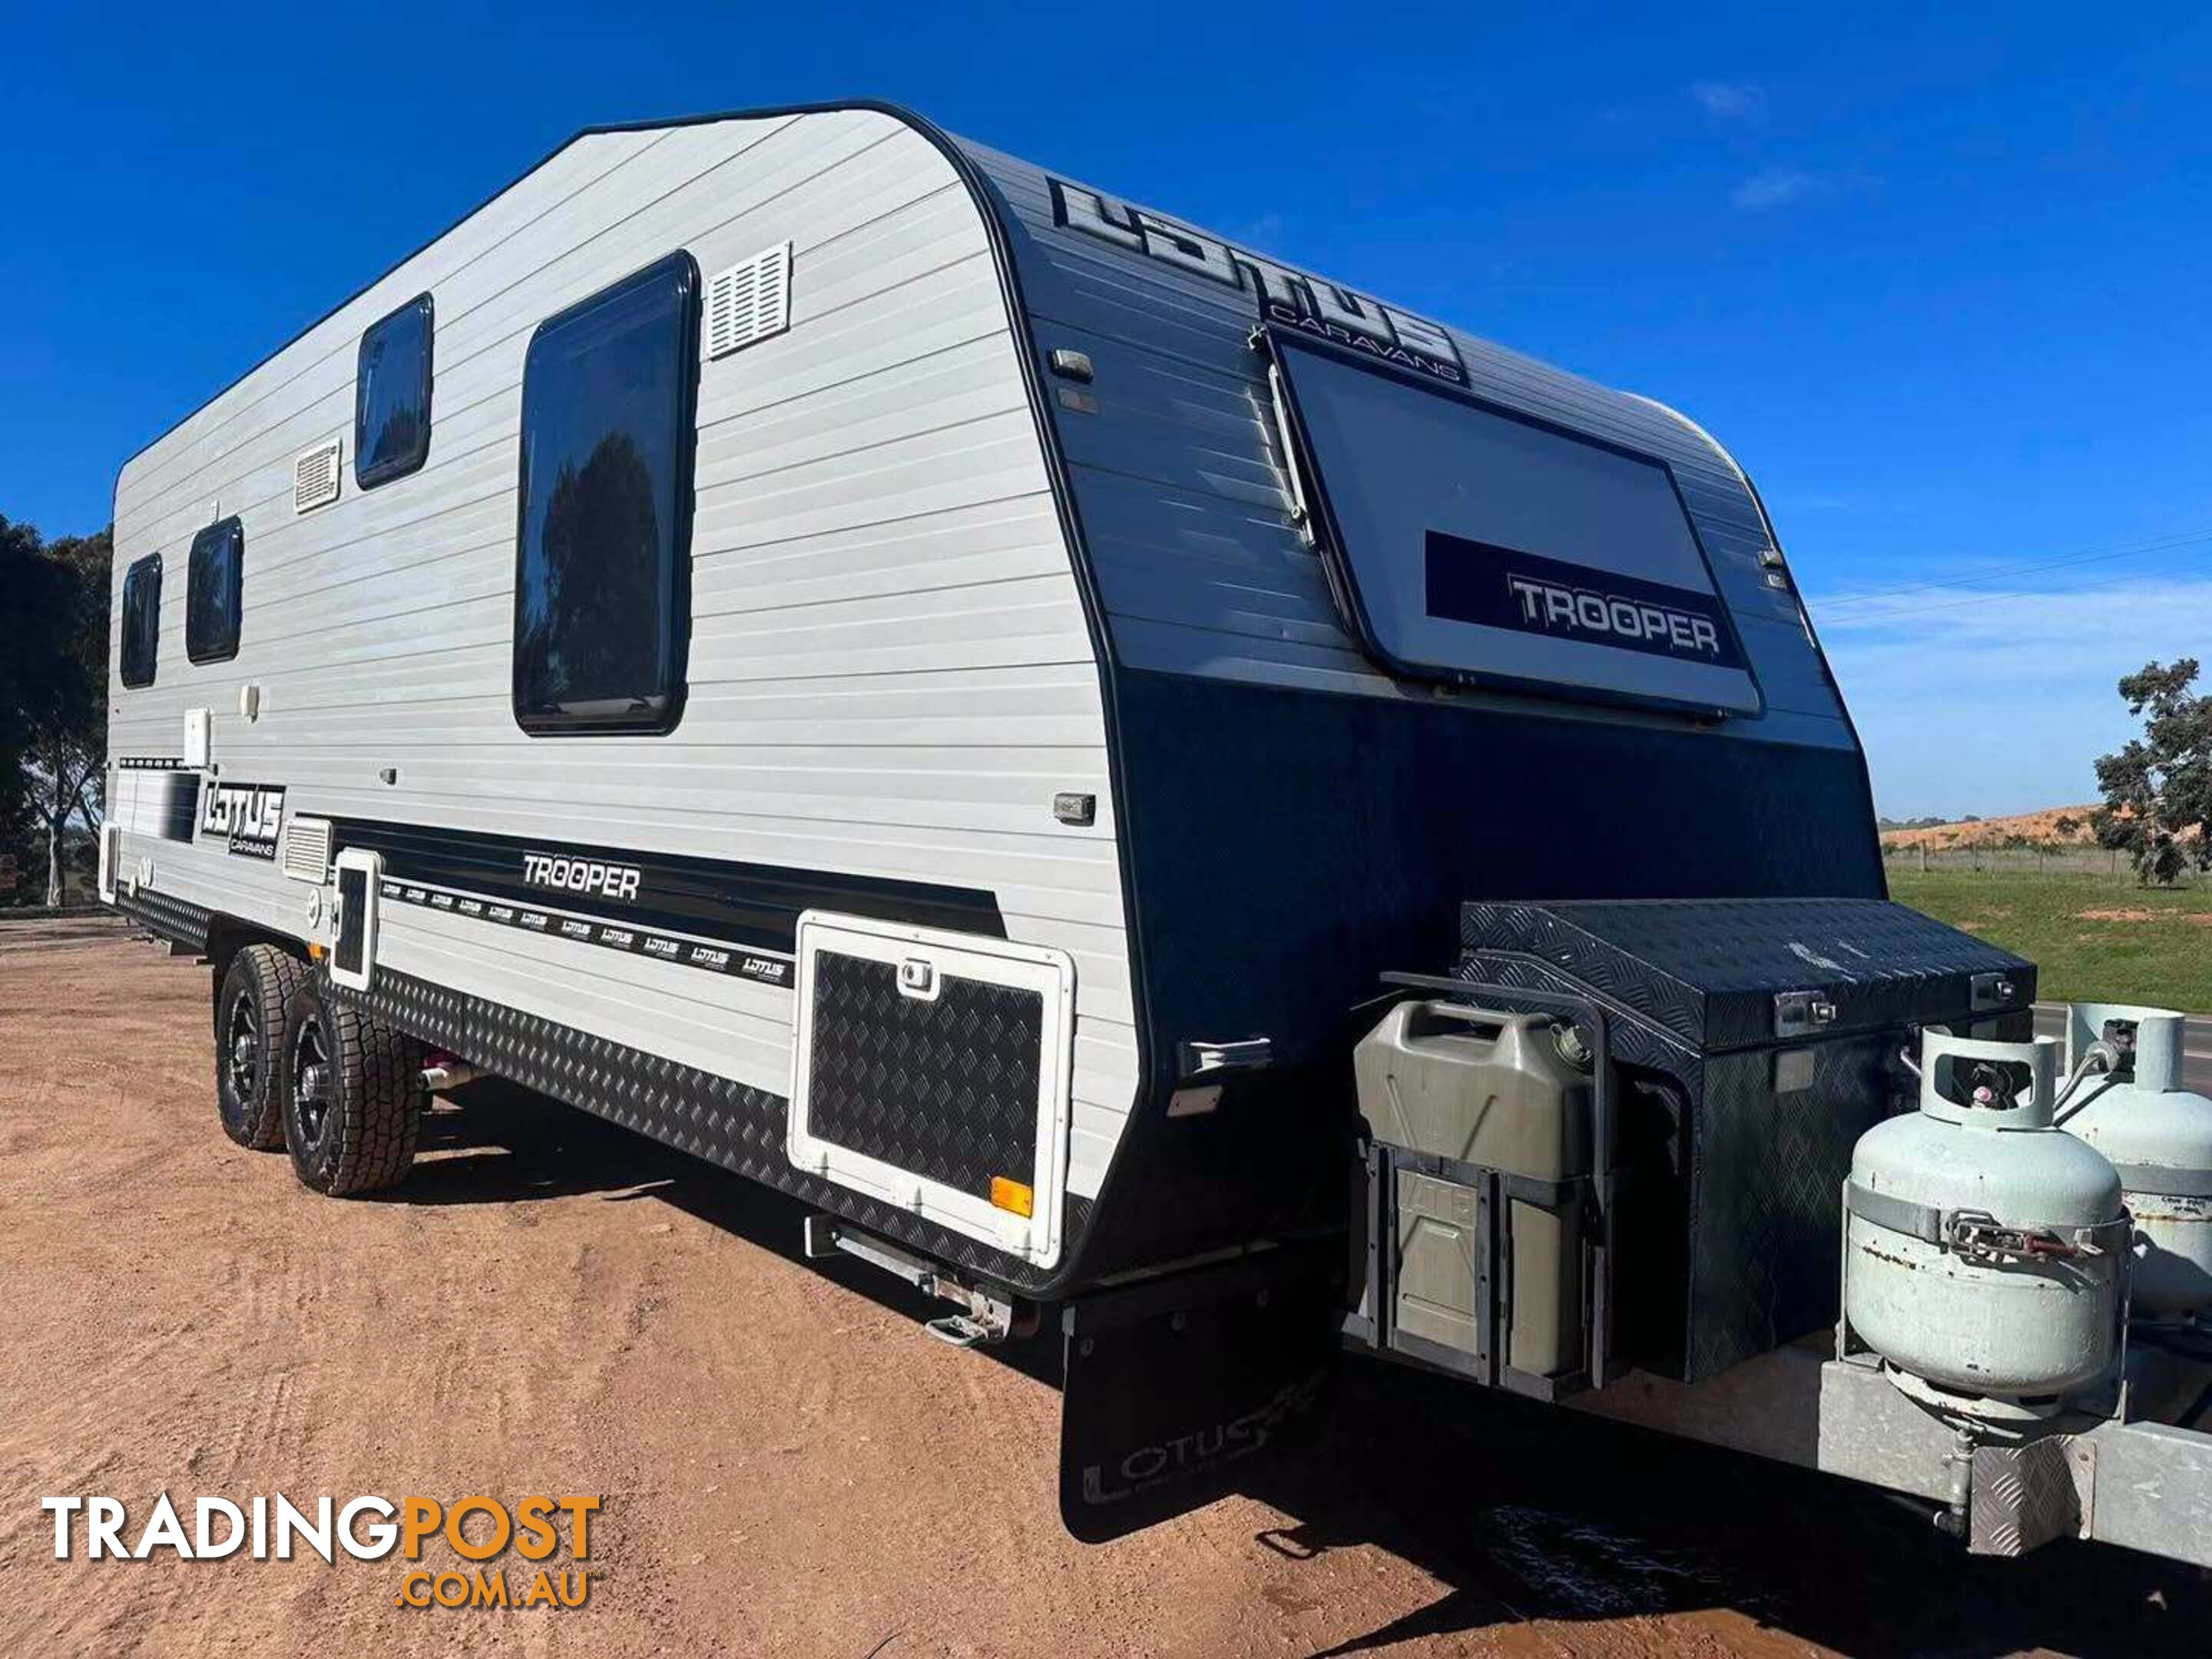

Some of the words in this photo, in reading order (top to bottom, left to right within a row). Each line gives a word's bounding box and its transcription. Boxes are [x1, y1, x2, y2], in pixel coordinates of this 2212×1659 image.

[1057, 181, 1464, 361] LOTUS
[1269, 303, 1461, 382] CARAVANS
[1511, 578, 1720, 653] TROOPER
[203, 788, 283, 839] LOTUS
[523, 853, 641, 900] TROOPER
[644, 937, 680, 954] LOTUS
[691, 946, 730, 965] LOTUS
[742, 957, 786, 976] LOTUS
